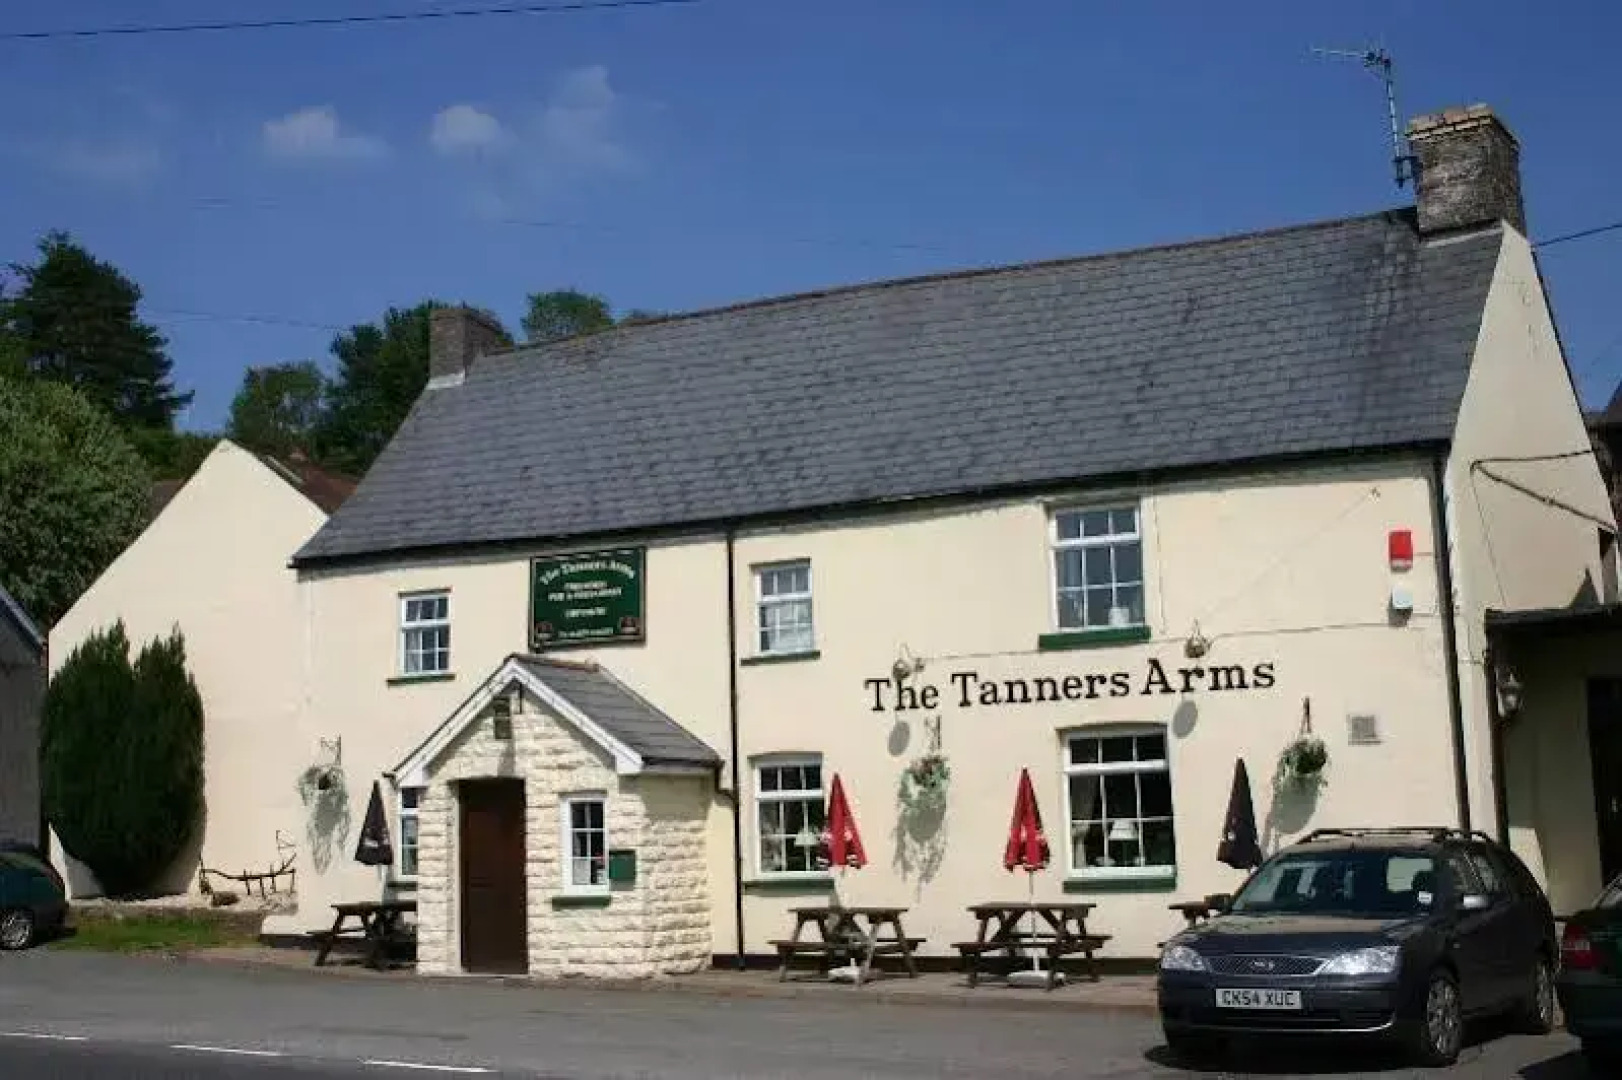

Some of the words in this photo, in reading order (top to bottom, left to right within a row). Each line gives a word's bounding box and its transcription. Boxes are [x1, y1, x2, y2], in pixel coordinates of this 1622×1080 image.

[864, 678, 939, 712] The
[951, 671, 1130, 708] Tanners
[1140, 658, 1276, 695] Arms
